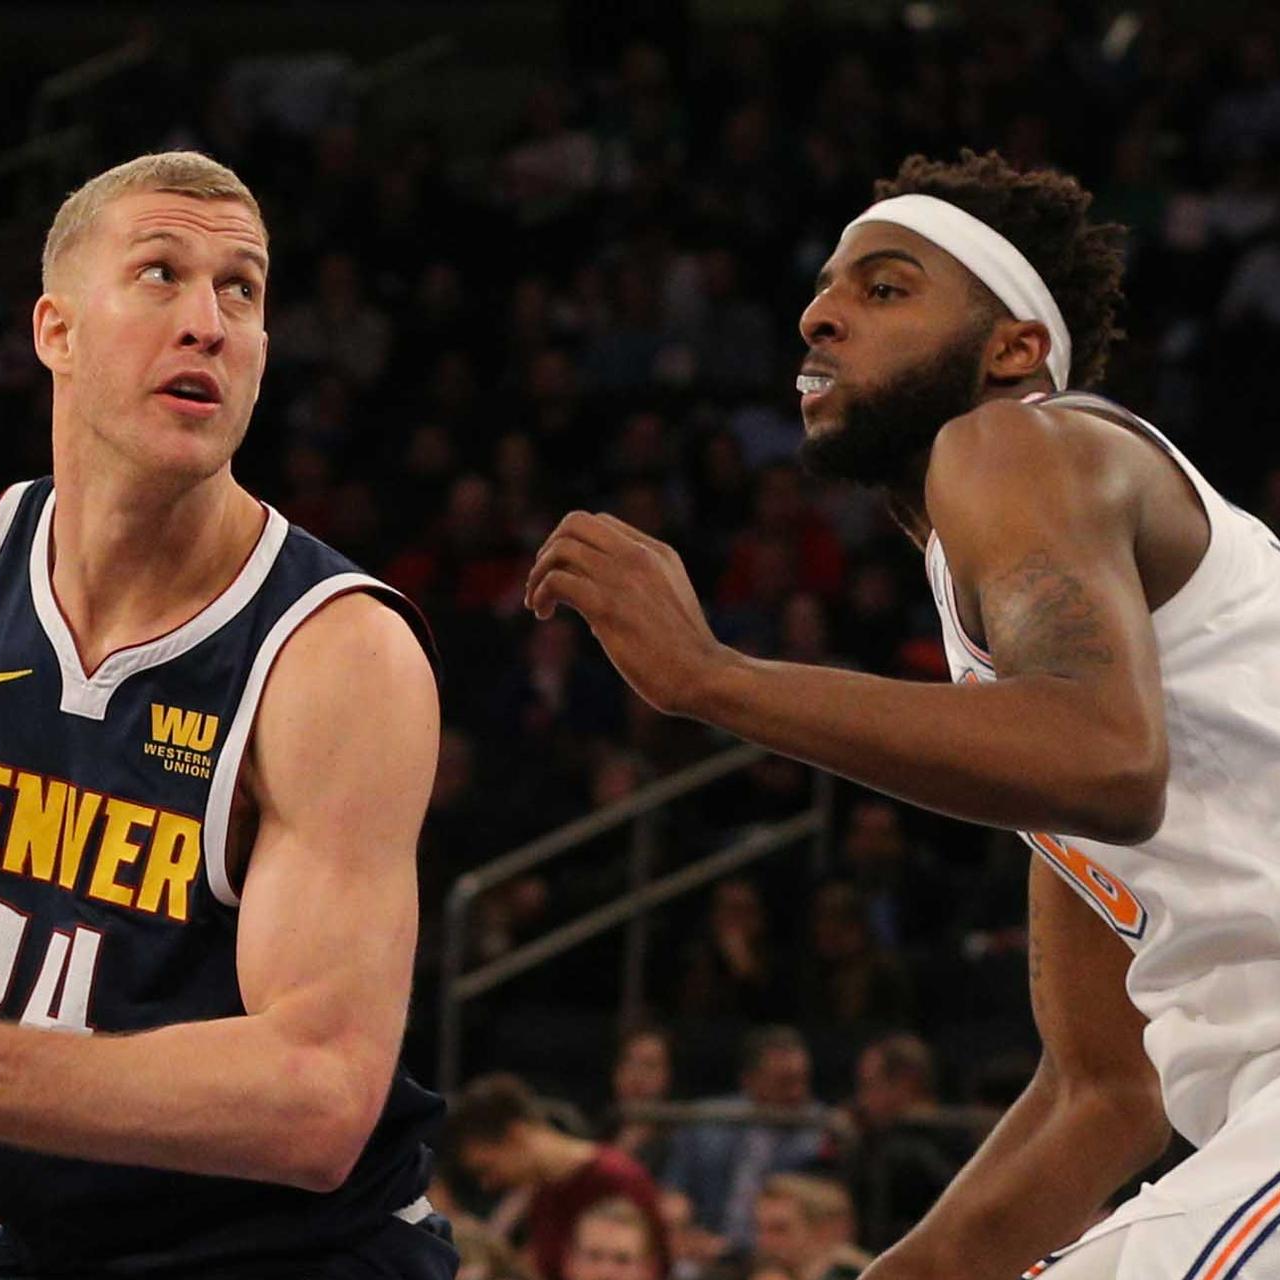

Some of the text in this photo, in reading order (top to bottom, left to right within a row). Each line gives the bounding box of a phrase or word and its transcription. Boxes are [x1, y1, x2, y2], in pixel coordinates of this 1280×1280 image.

[150, 702, 220, 753] WU
[143, 742, 213, 768] WESTERN
[163, 759, 211, 779] UNION
